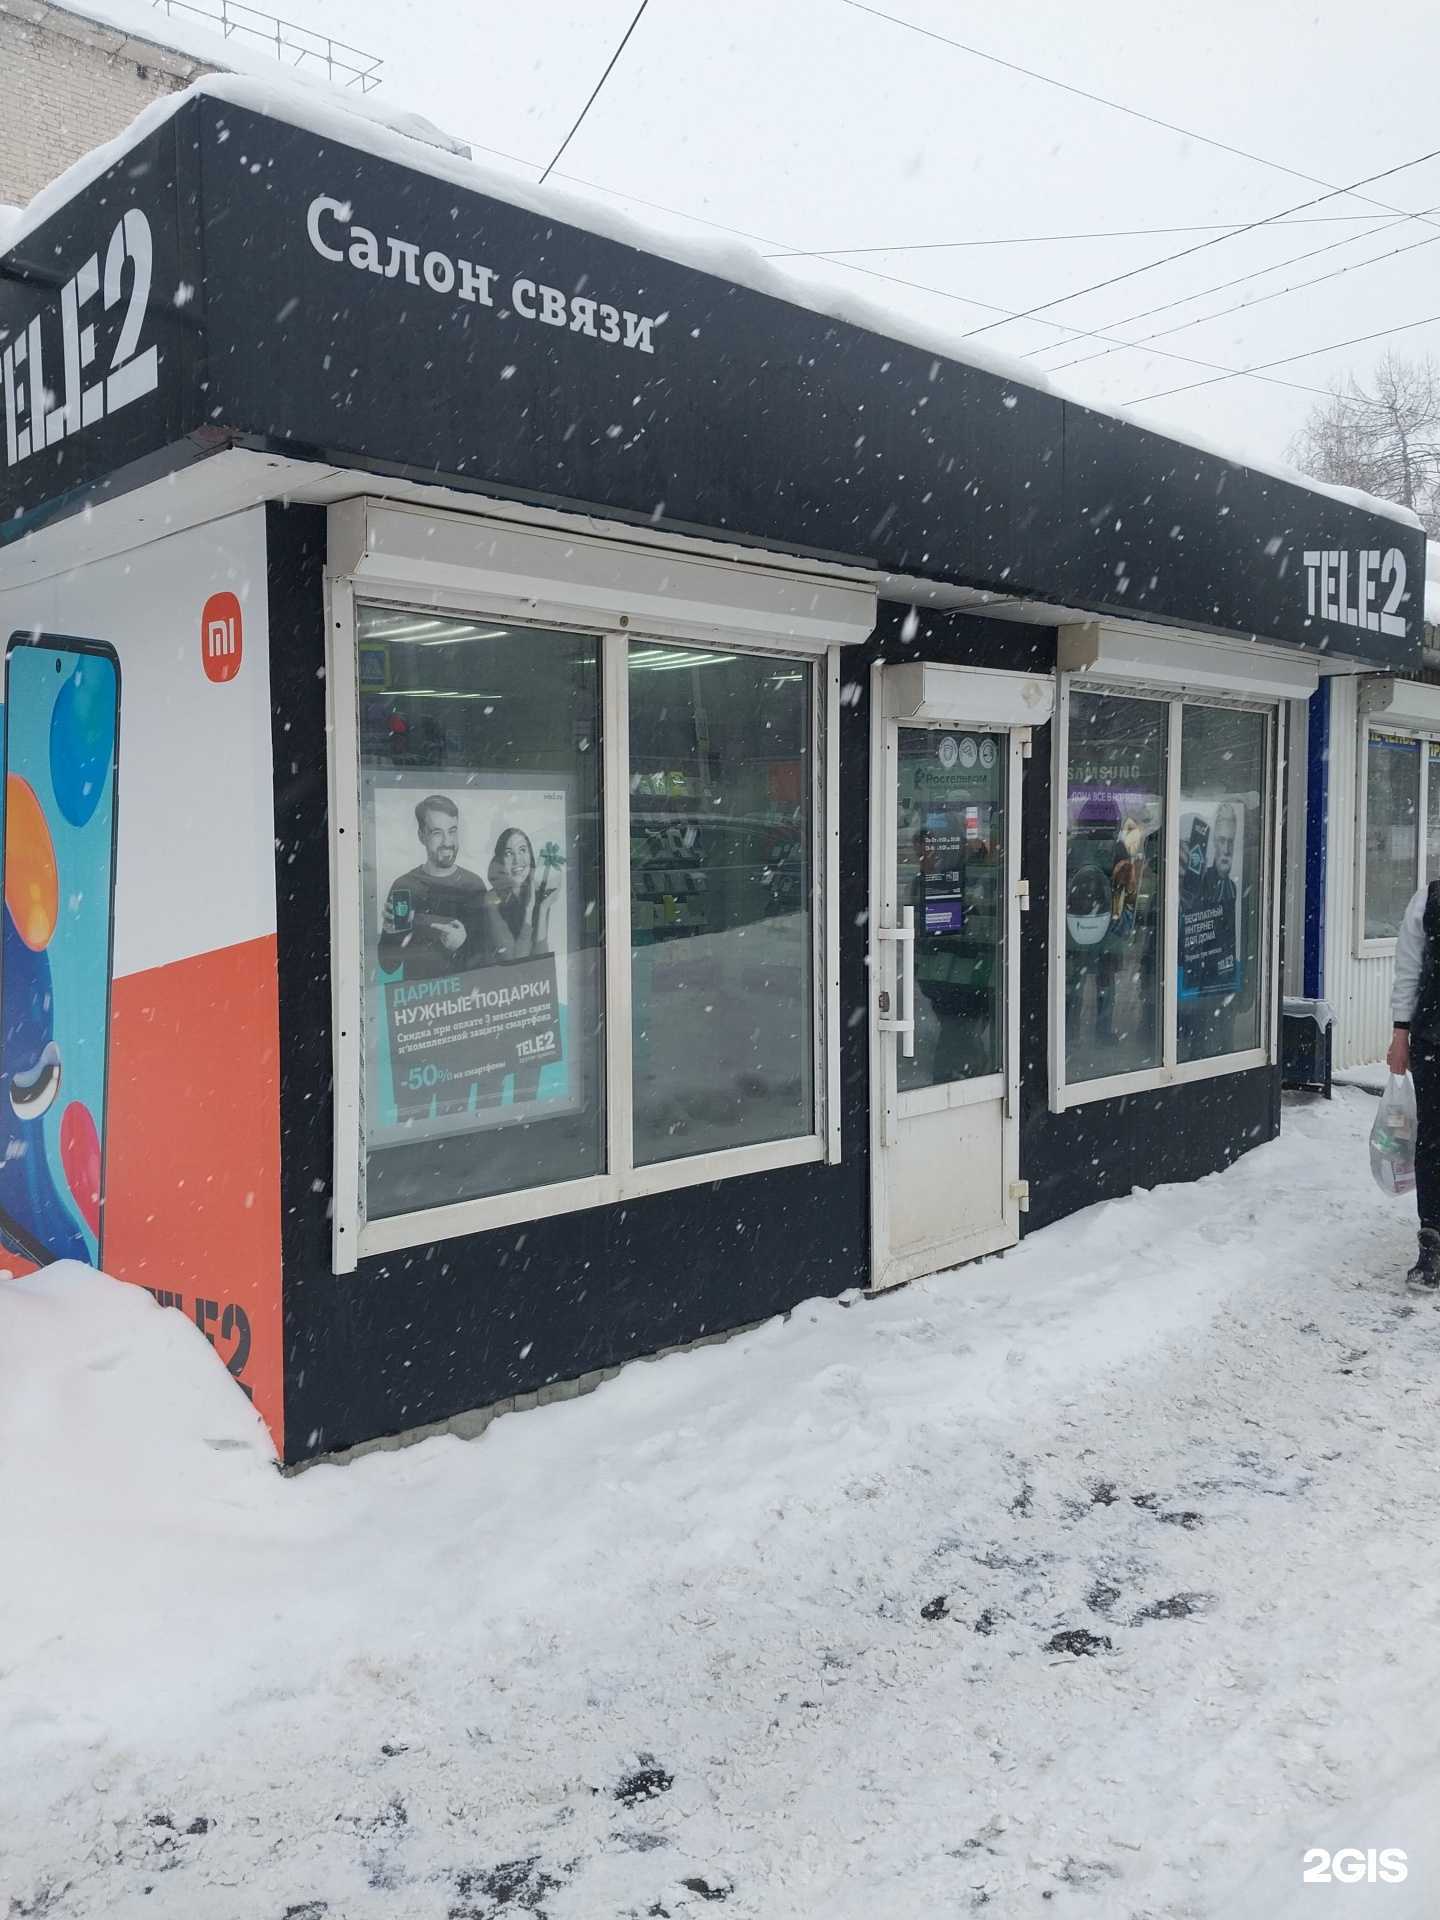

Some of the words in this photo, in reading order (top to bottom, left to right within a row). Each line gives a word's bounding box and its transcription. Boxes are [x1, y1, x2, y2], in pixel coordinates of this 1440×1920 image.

[306, 196, 494, 307] Салон
[511, 278, 655, 354] связи
[0, 208, 158, 467] ELE2
[1303, 547, 1407, 638] TELE2
[1067, 765, 1140, 780] SAMSUNG
[393, 976, 462, 1007] ДАРИТЕ
[394, 995, 473, 1027] НУЖНЫЕ
[474, 979, 551, 1009] ПОДАРКИ
[397, 1029, 432, 1043] Скидка
[516, 1030, 556, 1057] TELE2
